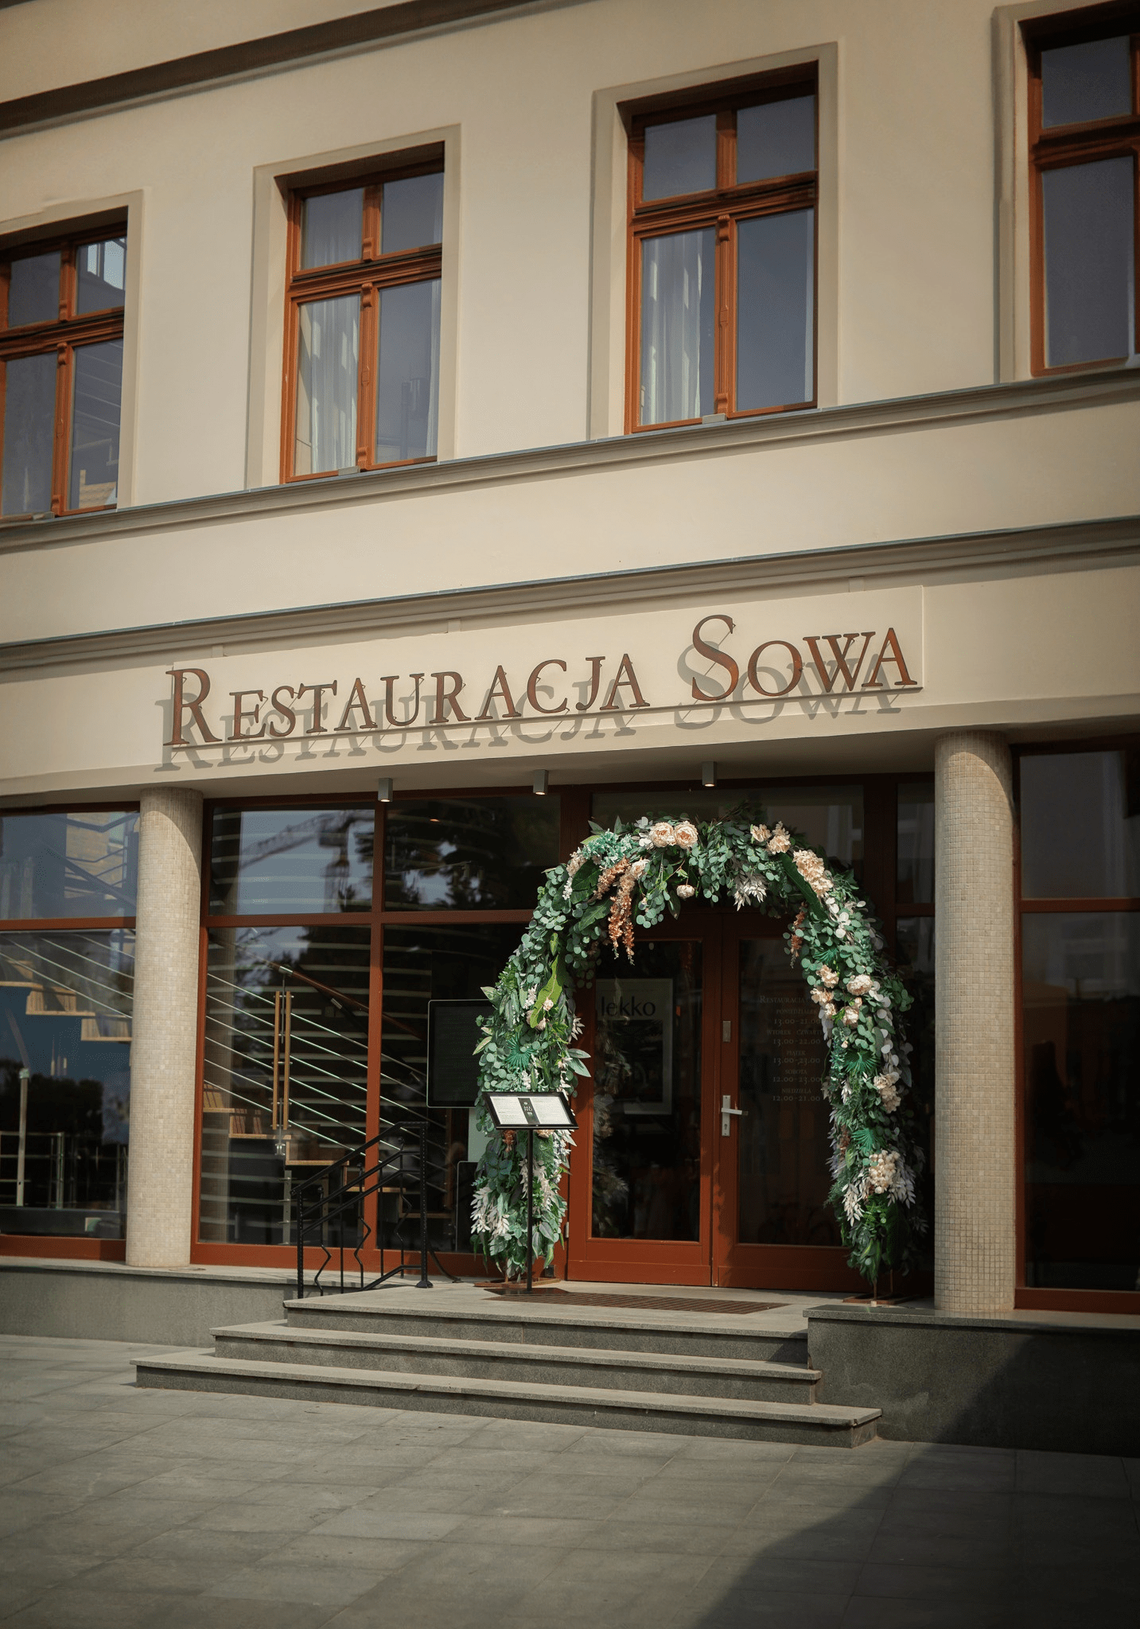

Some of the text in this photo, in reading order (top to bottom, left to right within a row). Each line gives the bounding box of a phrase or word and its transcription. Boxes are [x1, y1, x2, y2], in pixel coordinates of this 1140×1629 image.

[163, 614, 917, 746] RESTAURACJA SOWA
[601, 996, 656, 1016] lekko
